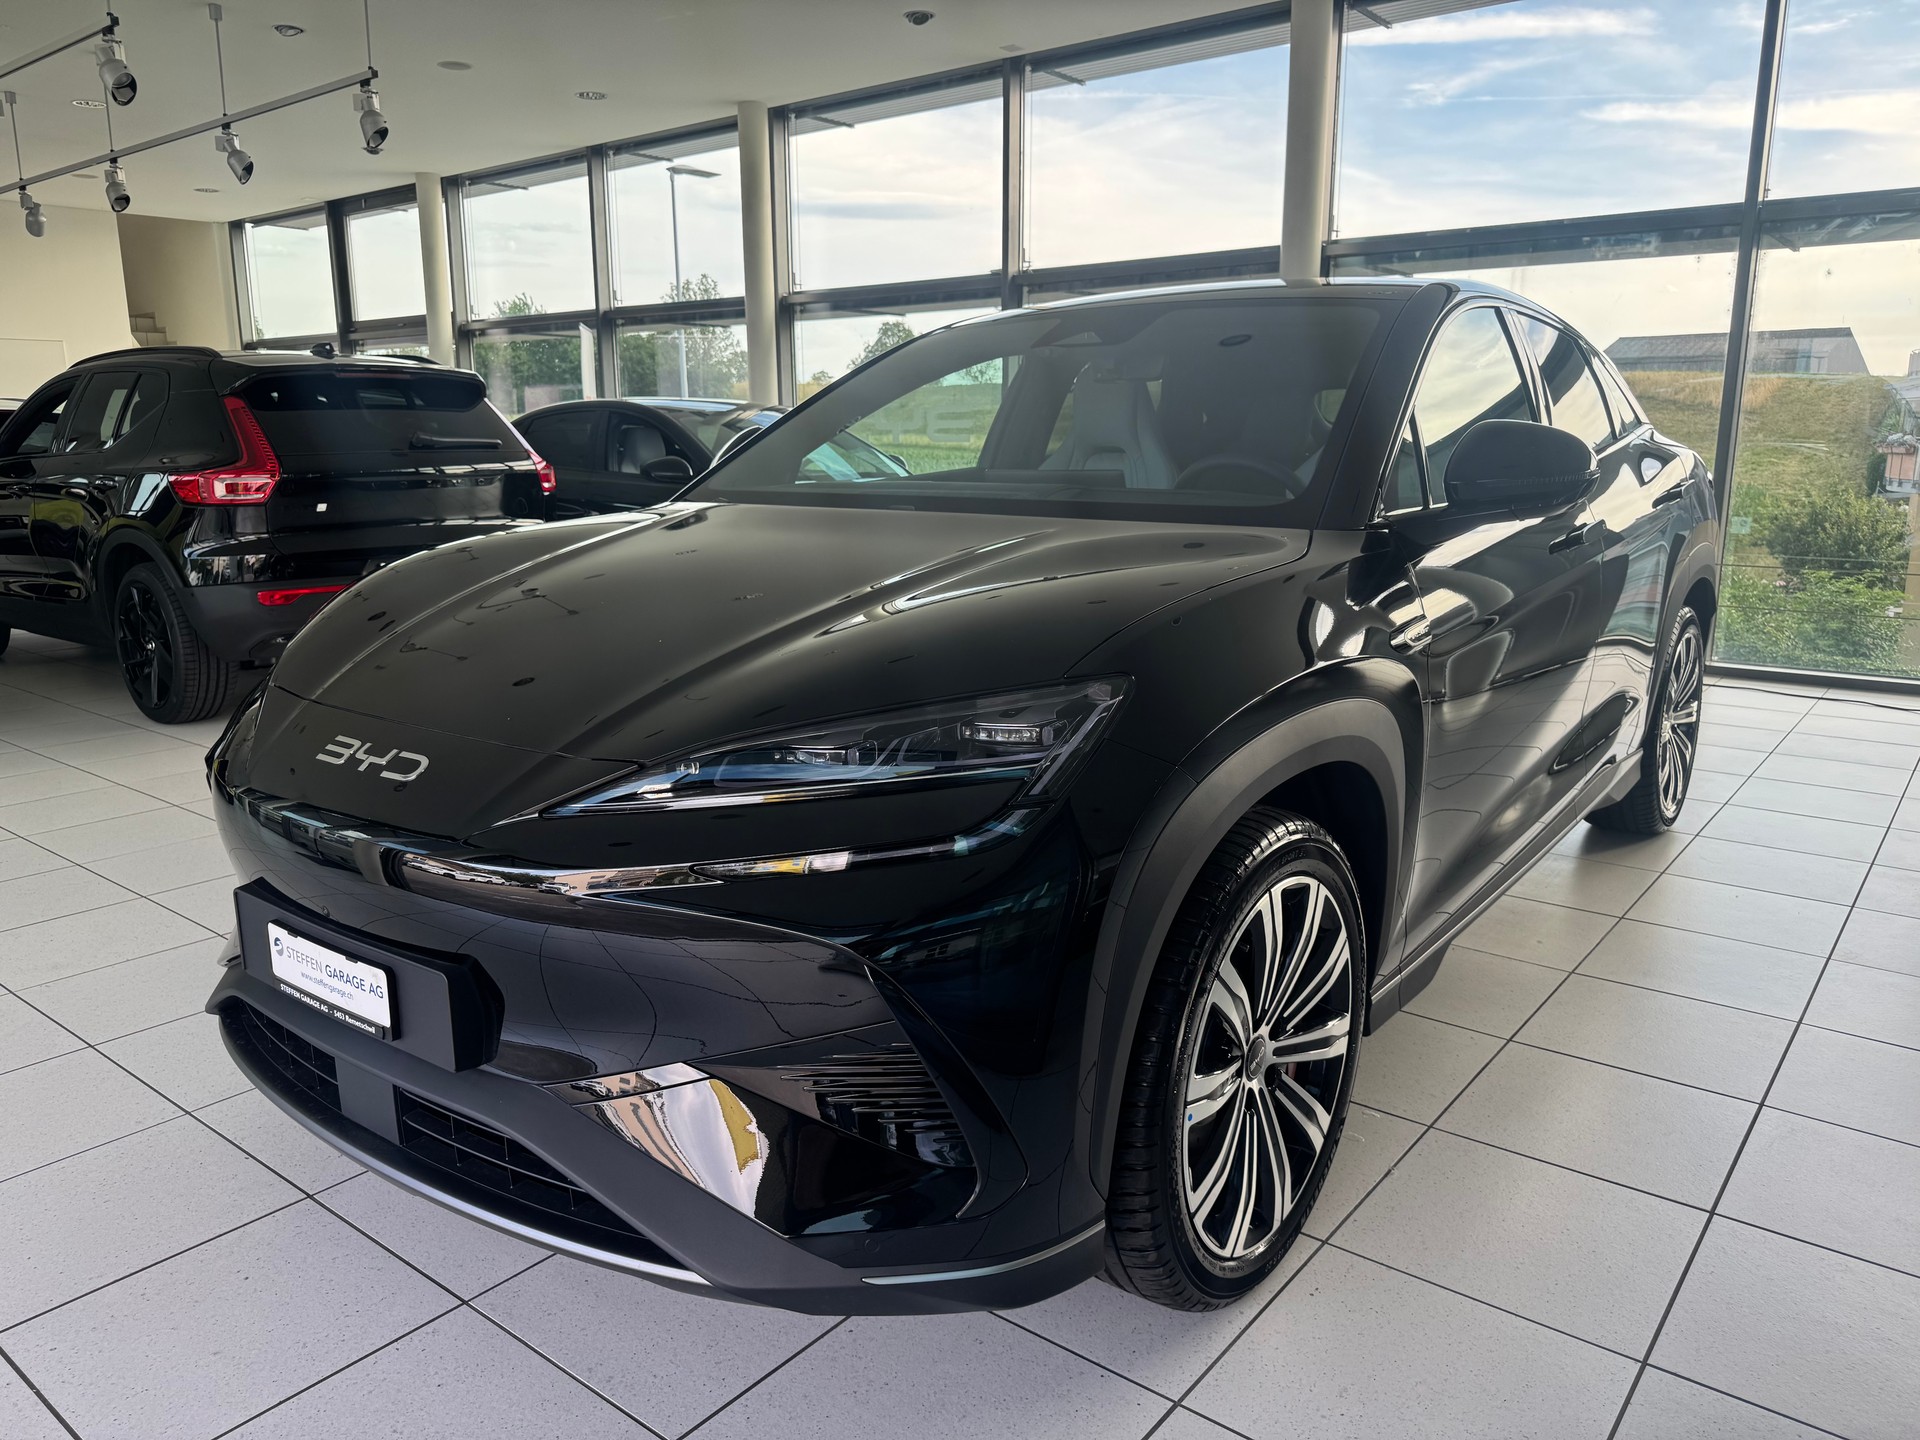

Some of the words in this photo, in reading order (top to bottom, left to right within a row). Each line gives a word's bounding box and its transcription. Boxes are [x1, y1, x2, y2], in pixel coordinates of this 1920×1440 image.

[315, 734, 430, 781] BYD
[286, 946, 323, 974] STEFFEN
[325, 964, 366, 992] GARAGE
[369, 982, 384, 999] AG
[300, 971, 355, 1001] www.steffengarage.ch
[280, 983, 301, 999] STEFFEN
[300, 993, 321, 1009] GARAGE
[320, 1003, 329, 1013] AG
